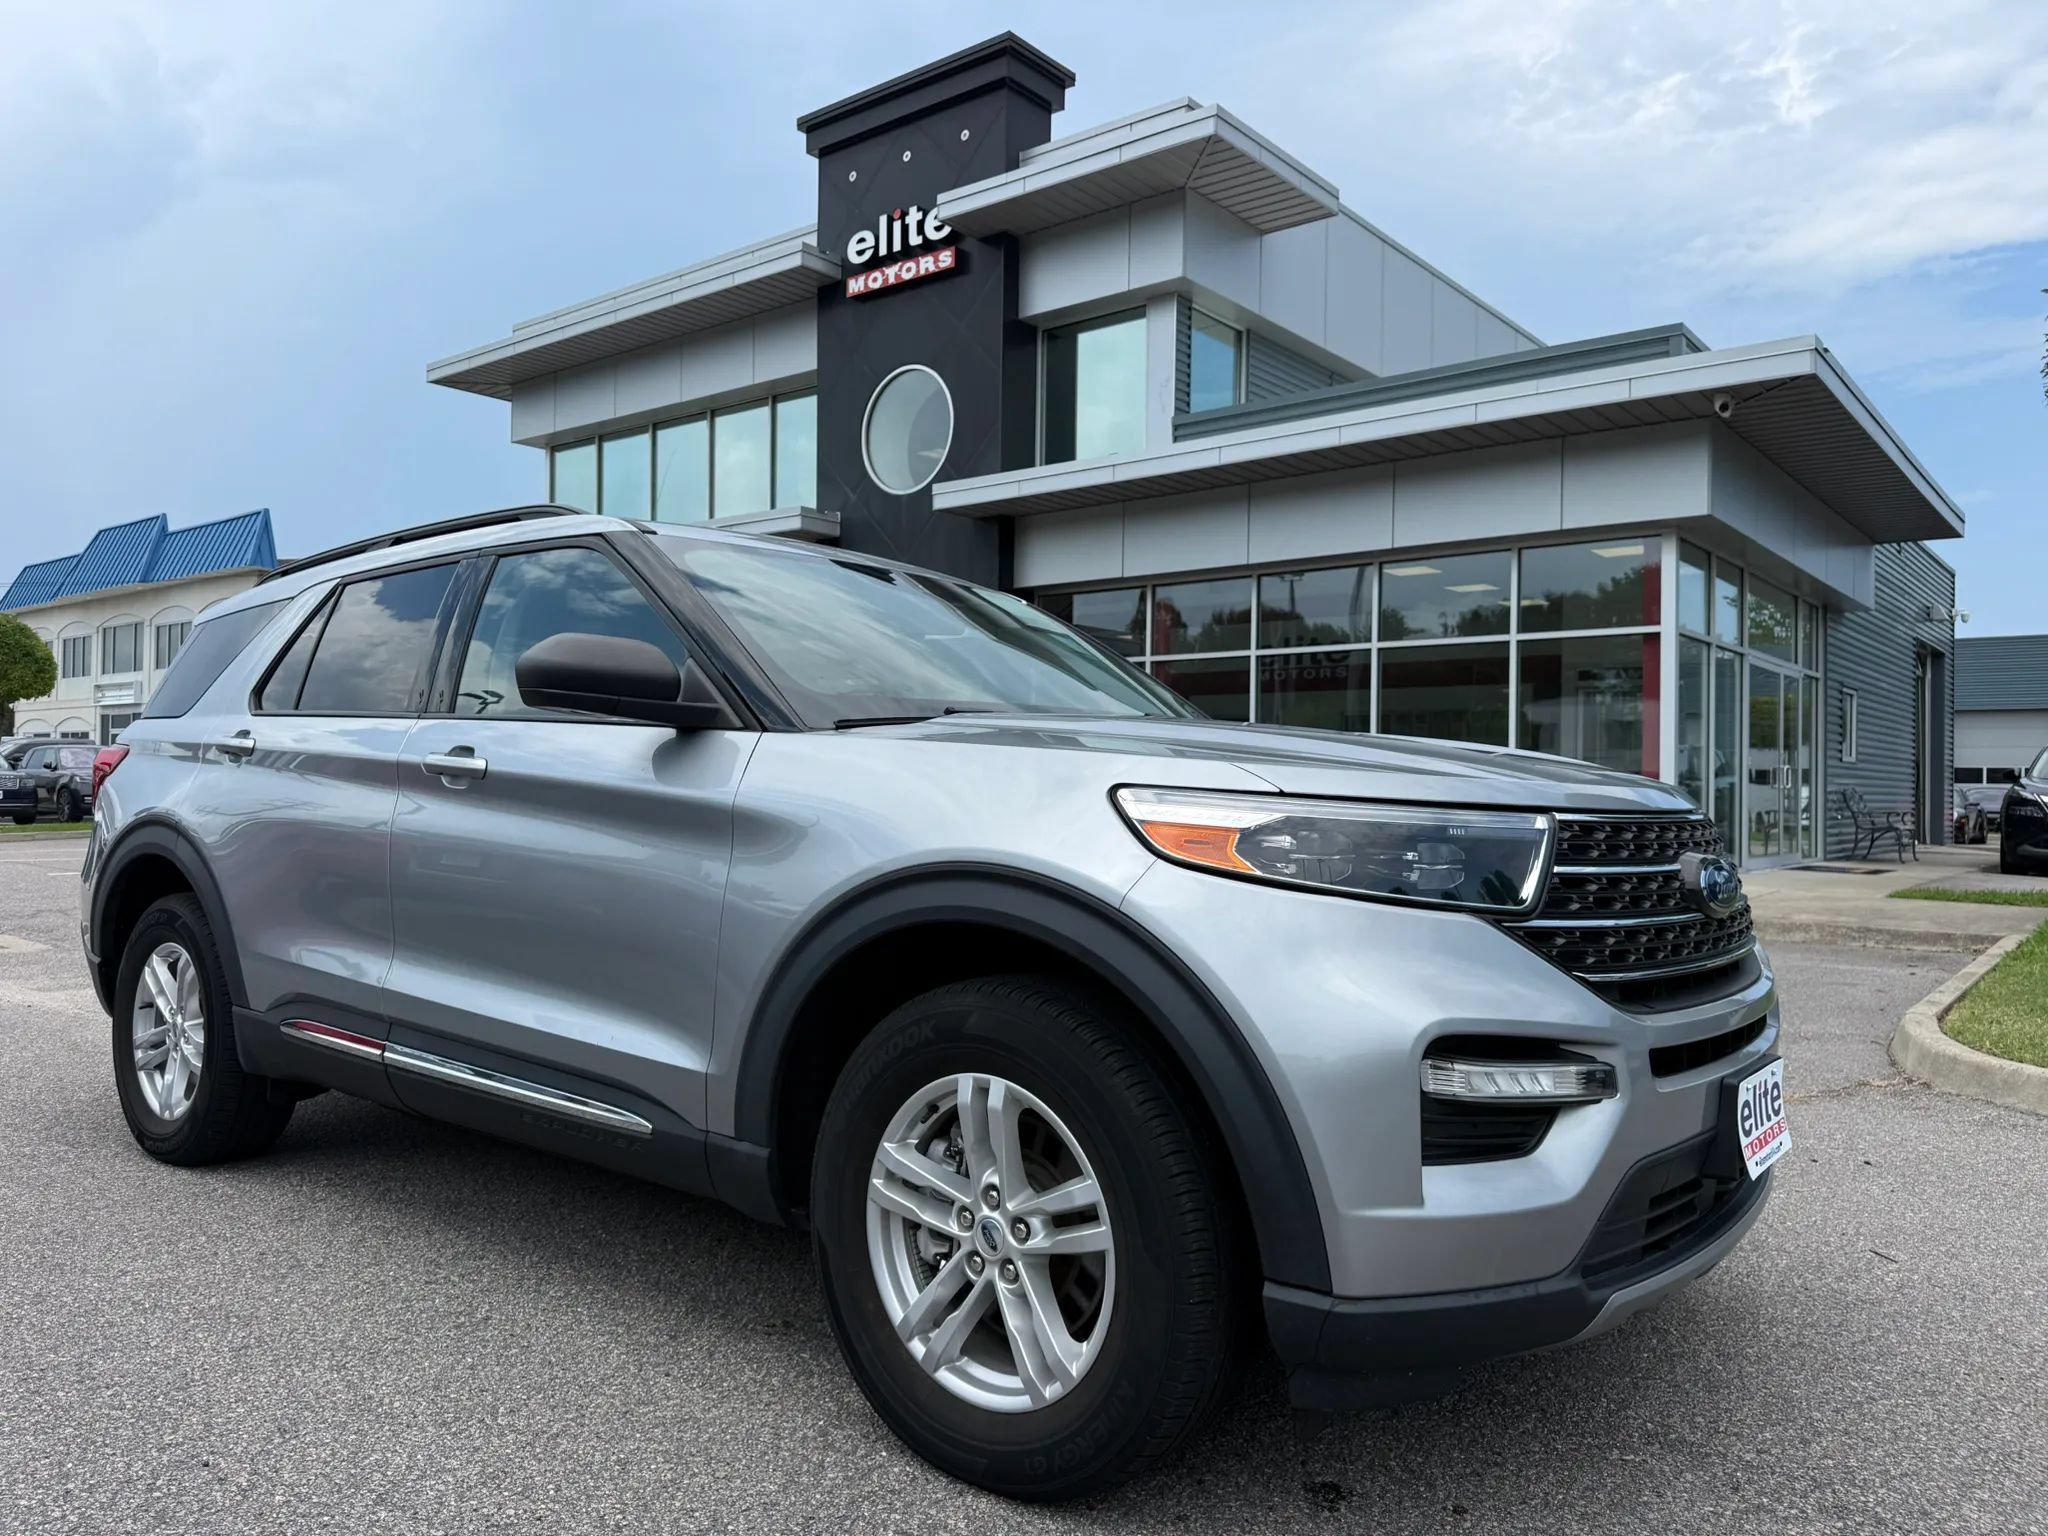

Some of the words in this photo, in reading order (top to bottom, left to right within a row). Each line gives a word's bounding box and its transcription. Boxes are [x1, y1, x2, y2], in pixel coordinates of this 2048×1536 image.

[847, 205, 952, 264] elite
[848, 250, 953, 293] MOTORS
[1740, 1079, 1782, 1138] elite
[1744, 1118, 1787, 1159] MOTORS
